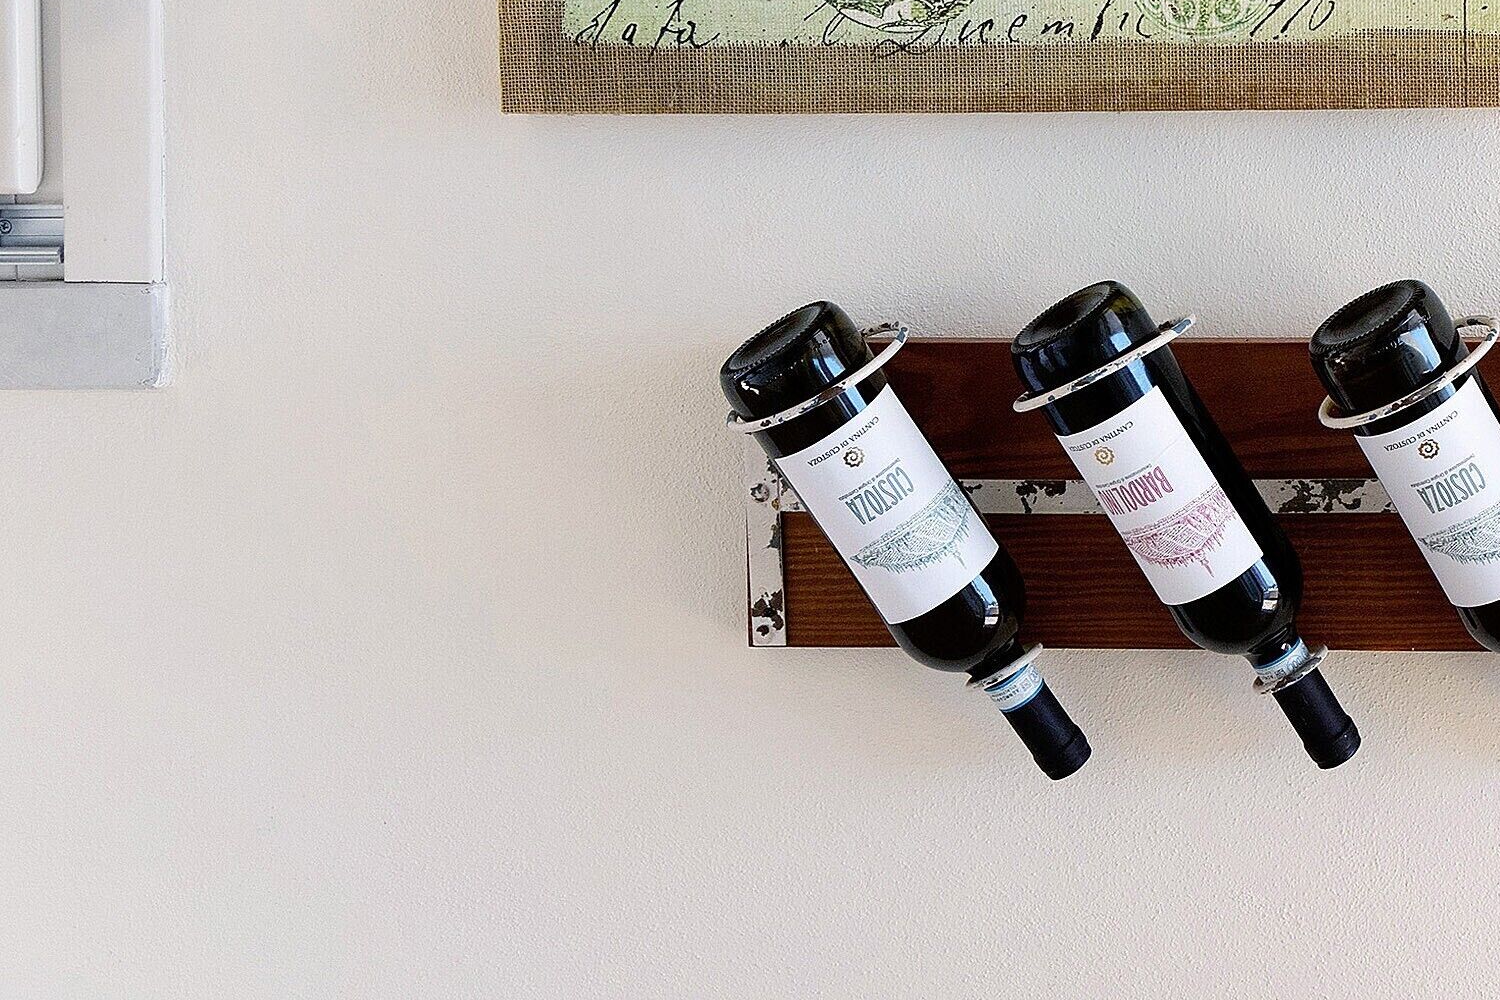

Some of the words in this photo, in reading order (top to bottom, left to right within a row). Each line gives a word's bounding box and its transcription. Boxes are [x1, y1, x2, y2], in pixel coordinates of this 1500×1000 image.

[848, 415, 879, 442] CANTINA
[1098, 420, 1134, 442] CANTINA
[1424, 410, 1458, 434] CANTINA
[839, 439, 849, 448] DI
[1383, 435, 1417, 452] CUSTOZA
[1416, 431, 1425, 439] DI
[806, 445, 841, 465] CUSTOZA
[844, 466, 915, 526] CUSTOZA
[1096, 465, 1173, 515] BARDOLINO
[1416, 463, 1486, 515] CUSTOZA
